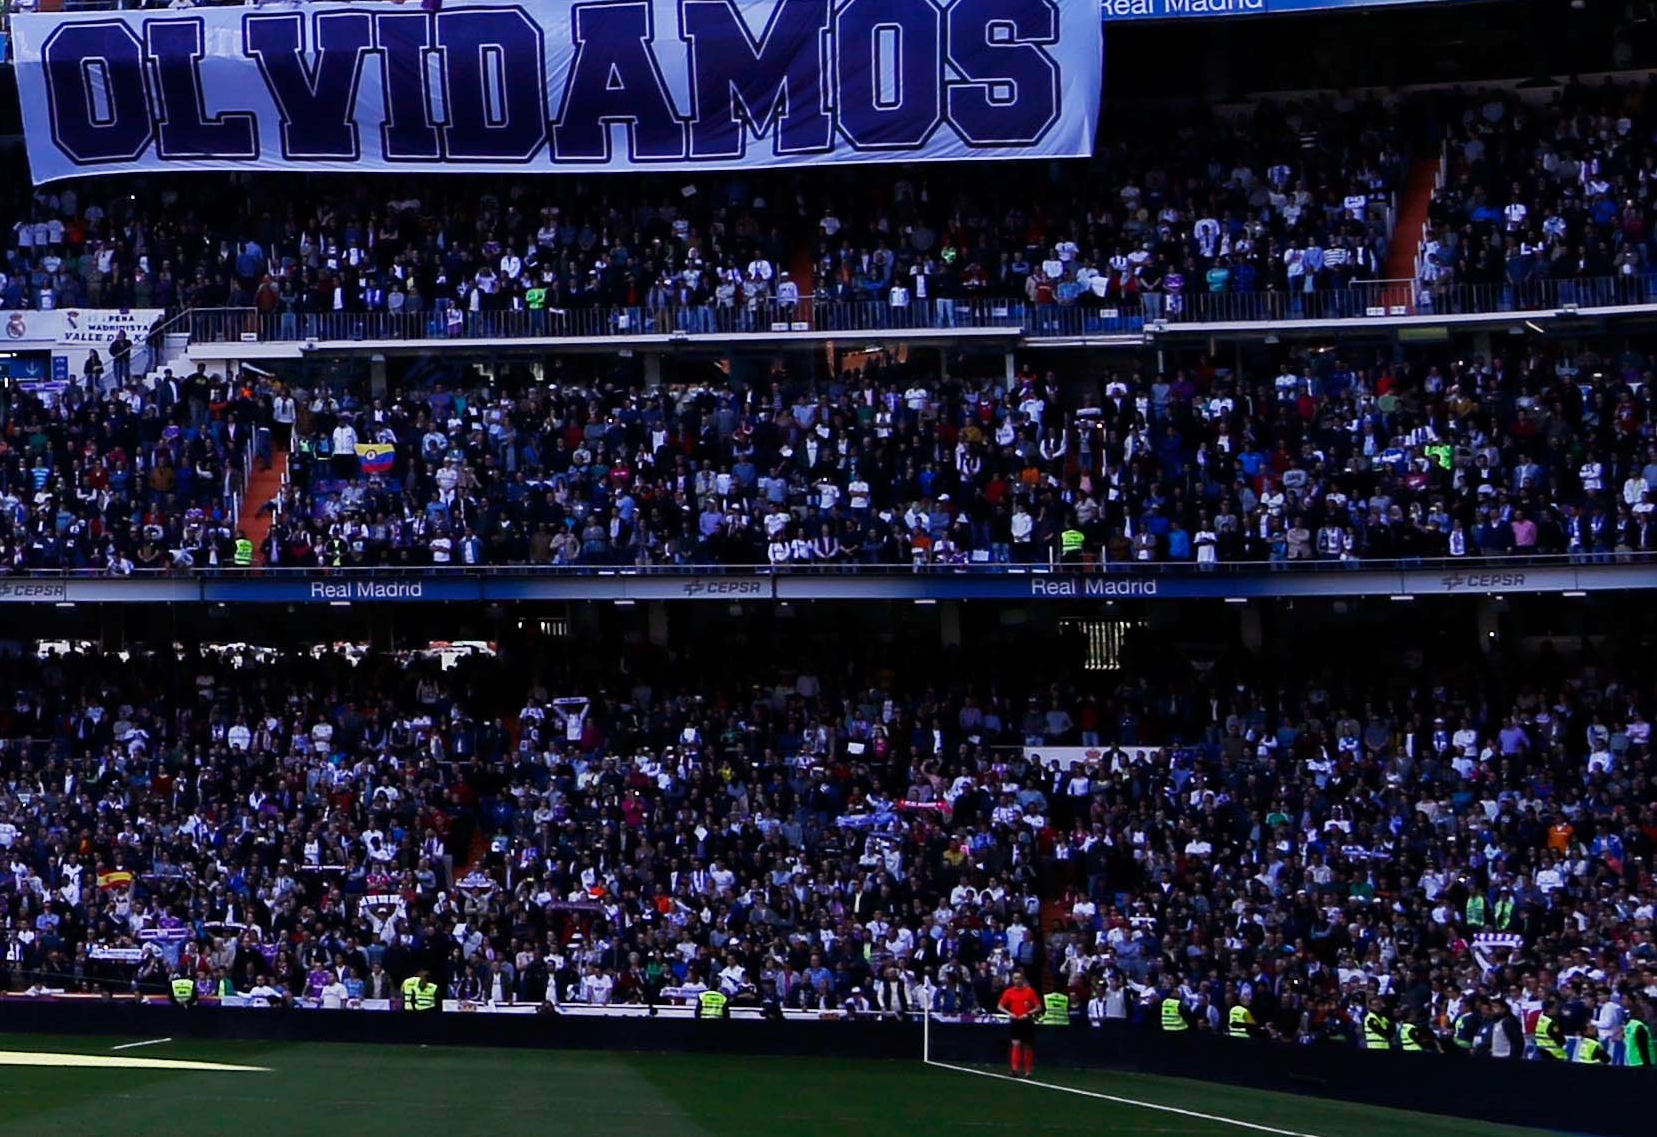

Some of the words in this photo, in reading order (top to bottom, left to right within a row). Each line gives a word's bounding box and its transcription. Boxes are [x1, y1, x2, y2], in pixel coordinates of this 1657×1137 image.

[65, 332, 103, 342] VALLE
[1032, 578, 1075, 594] Real
[1085, 578, 1157, 594] Madrid
[1467, 573, 1525, 587] CEPSA
[14, 585, 64, 596] CEPSA
[311, 582, 351, 597] Real
[357, 581, 422, 598] Madrid
[707, 581, 761, 594] CEPSA
